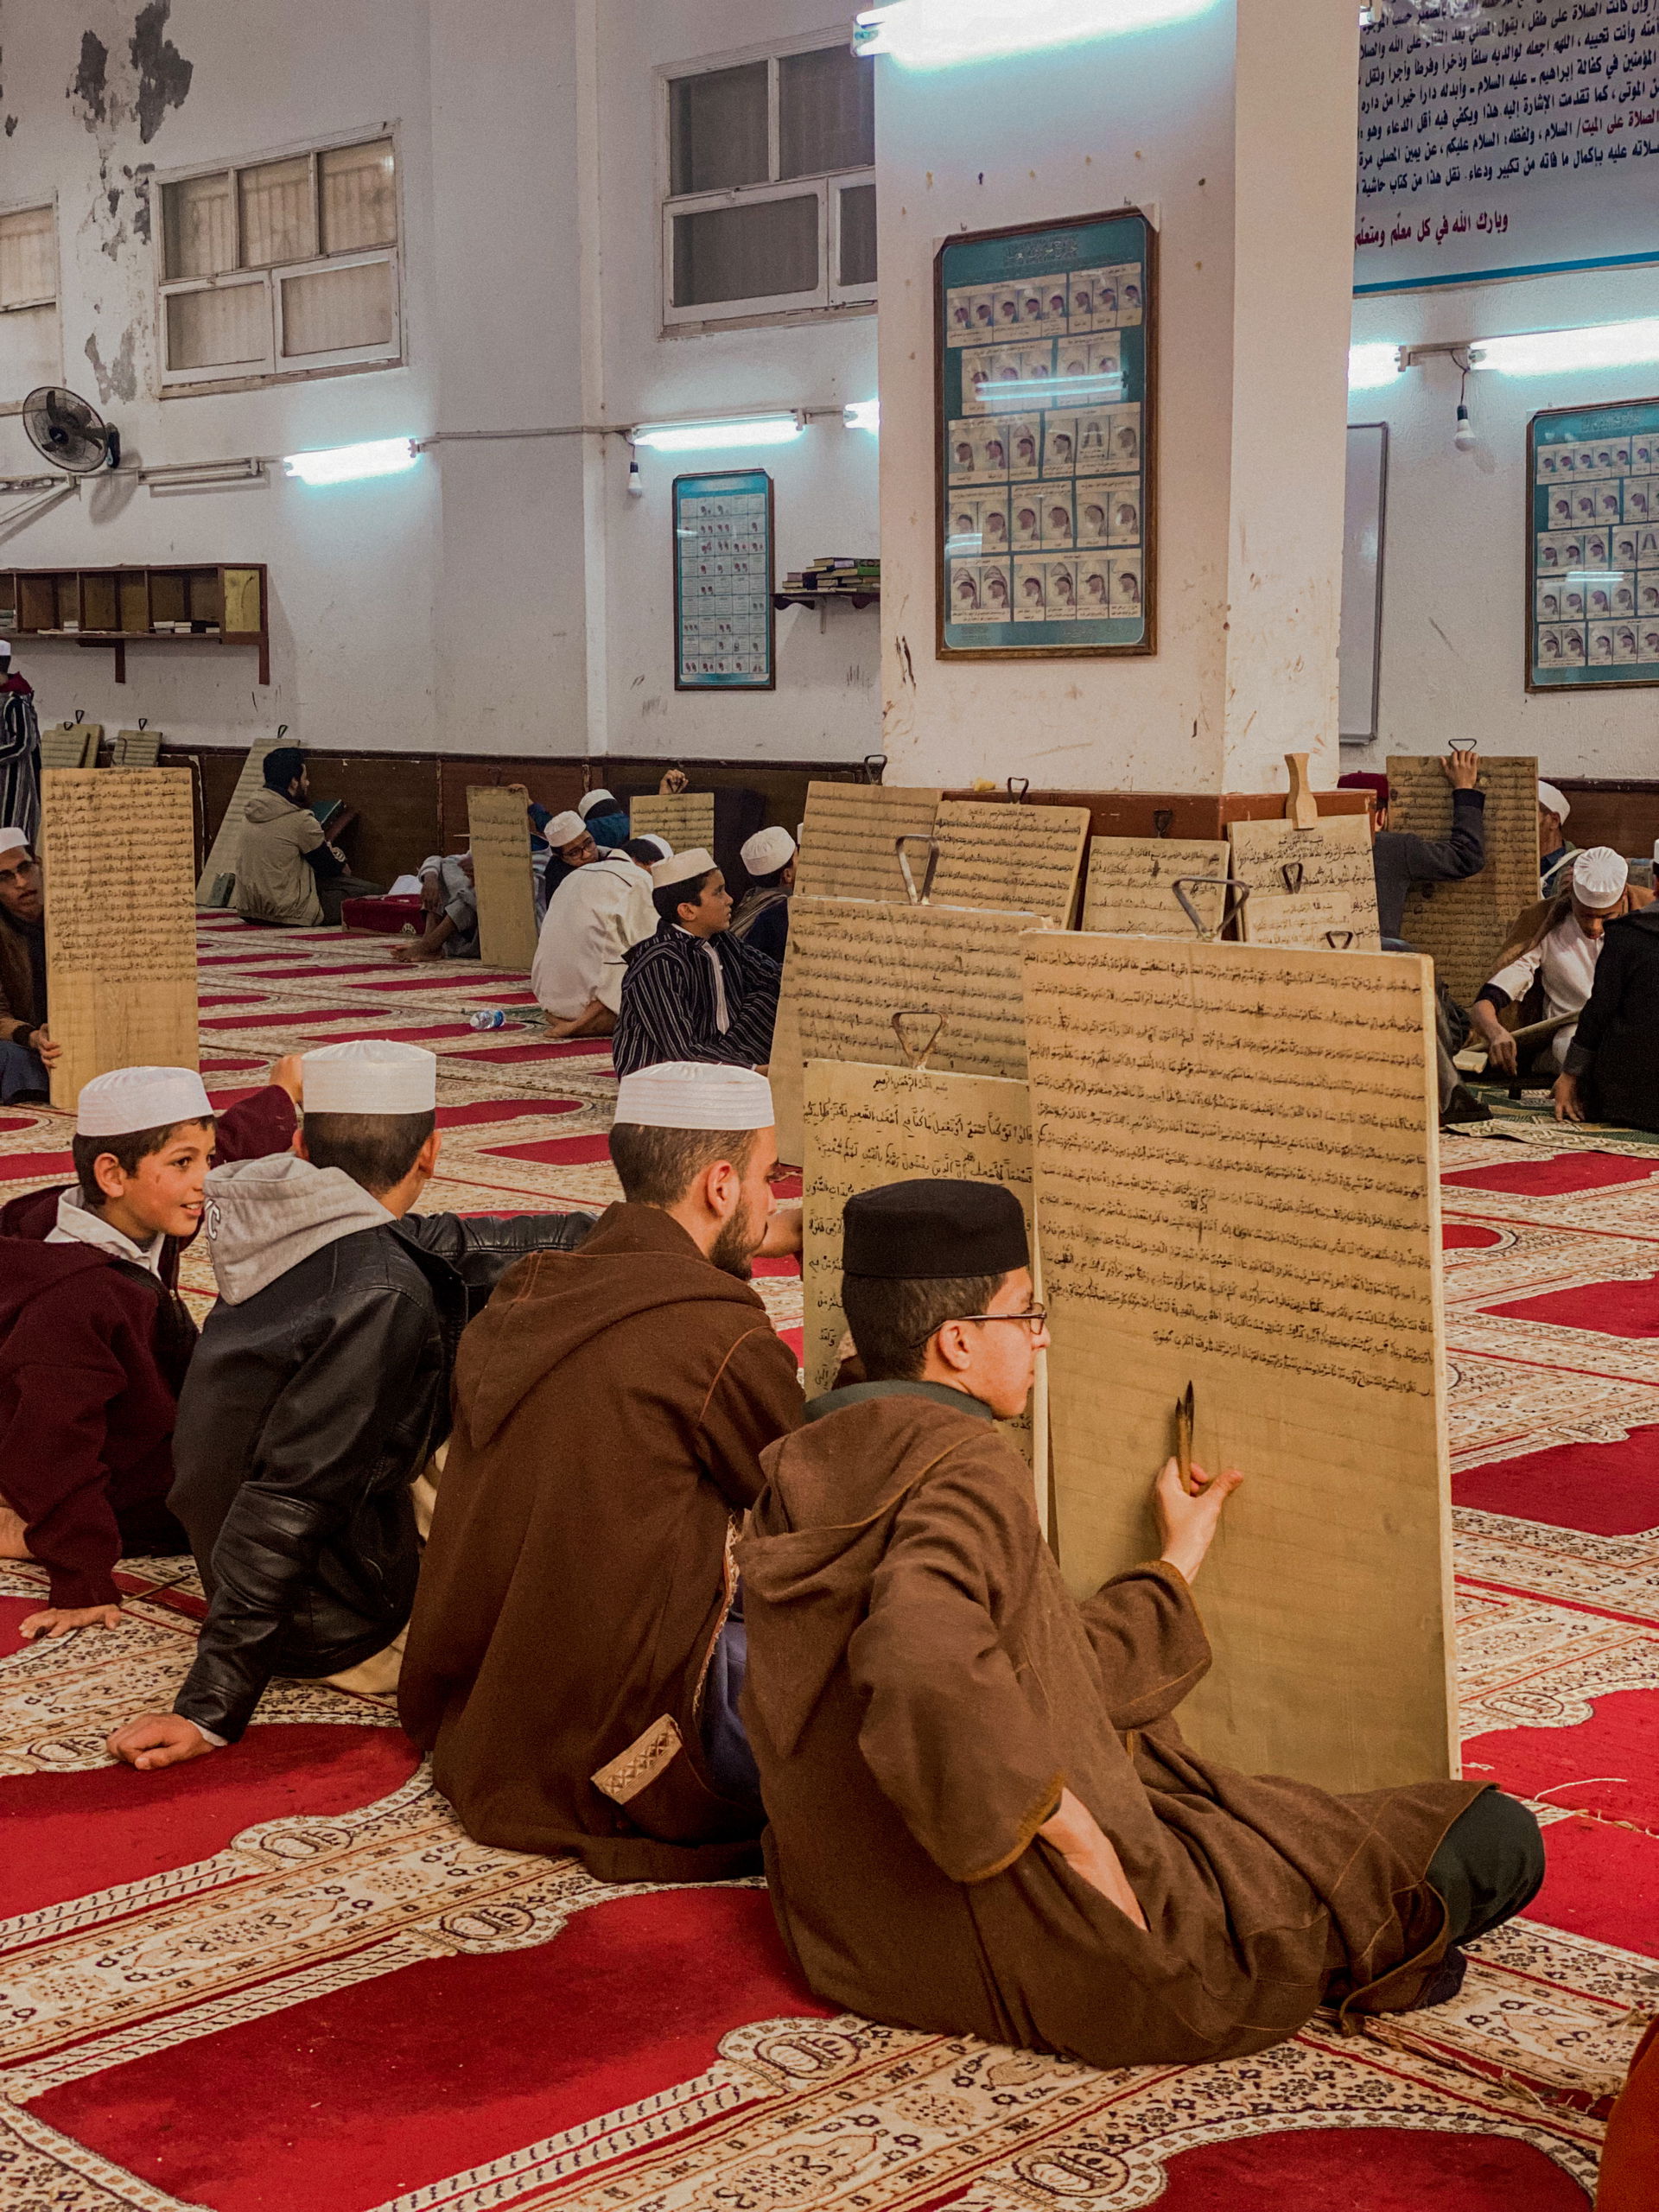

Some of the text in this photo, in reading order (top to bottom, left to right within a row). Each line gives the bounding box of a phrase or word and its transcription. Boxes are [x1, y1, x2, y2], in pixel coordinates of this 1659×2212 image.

[1551, 7, 1567, 29] على
[1573, 3, 1602, 20] الصلاة
[1498, 16, 1518, 36] يقول
[1614, 22, 1635, 43] وأنت
[1389, 35, 1403, 52] الله
[1407, 34, 1421, 54] على
[1527, 39, 1550, 57] اجعله
[1554, 32, 1573, 54] اللهم
[1492, 42, 1522, 66] لوالديه
[1623, 49, 1656, 73] المؤمنين
[1577, 55, 1602, 75] كفالة
[1606, 54, 1618, 79] في
[1440, 77, 1466, 100] وأبدله
[1478, 73, 1504, 96] السلام
[1509, 70, 1528, 90] عليه
[1382, 92, 1394, 112] من
[1559, 87, 1590, 107] تقدمت
[1595, 85, 1608, 102] كما
[1361, 96, 1379, 114] داره
[1484, 103, 1499, 118] هذا
[1523, 93, 1554, 115] الإشارة
[1387, 118, 1413, 136] الدعاء
[1417, 110, 1431, 133] أقل
[1434, 110, 1448, 130] فيه
[1452, 106, 1478, 130] ويكفي
[1607, 114, 1624, 134] على
[1425, 142, 1436, 161] عن
[1472, 131, 1499, 152] السلام
[1359, 151, 1372, 170] مرة
[1377, 146, 1401, 170] المصلي
[1405, 145, 1421, 163] يمين
[1540, 151, 1557, 168] فاته
[1562, 151, 1569, 167] ما
[1608, 143, 1627, 163] عليه
[1446, 166, 1460, 186] نقل
[1497, 157, 1519, 179] تكبير
[1523, 156, 1535, 176] من
[1389, 173, 1408, 195] كتاب
[1411, 173, 1422, 192] من
[1427, 168, 1441, 185] هذا
[1362, 178, 1385, 197] حاشية
[1417, 217, 1431, 242] كل
[1435, 215, 1449, 245] في
[1452, 210, 1471, 232] الله
[1476, 210, 1509, 234] وبارك
